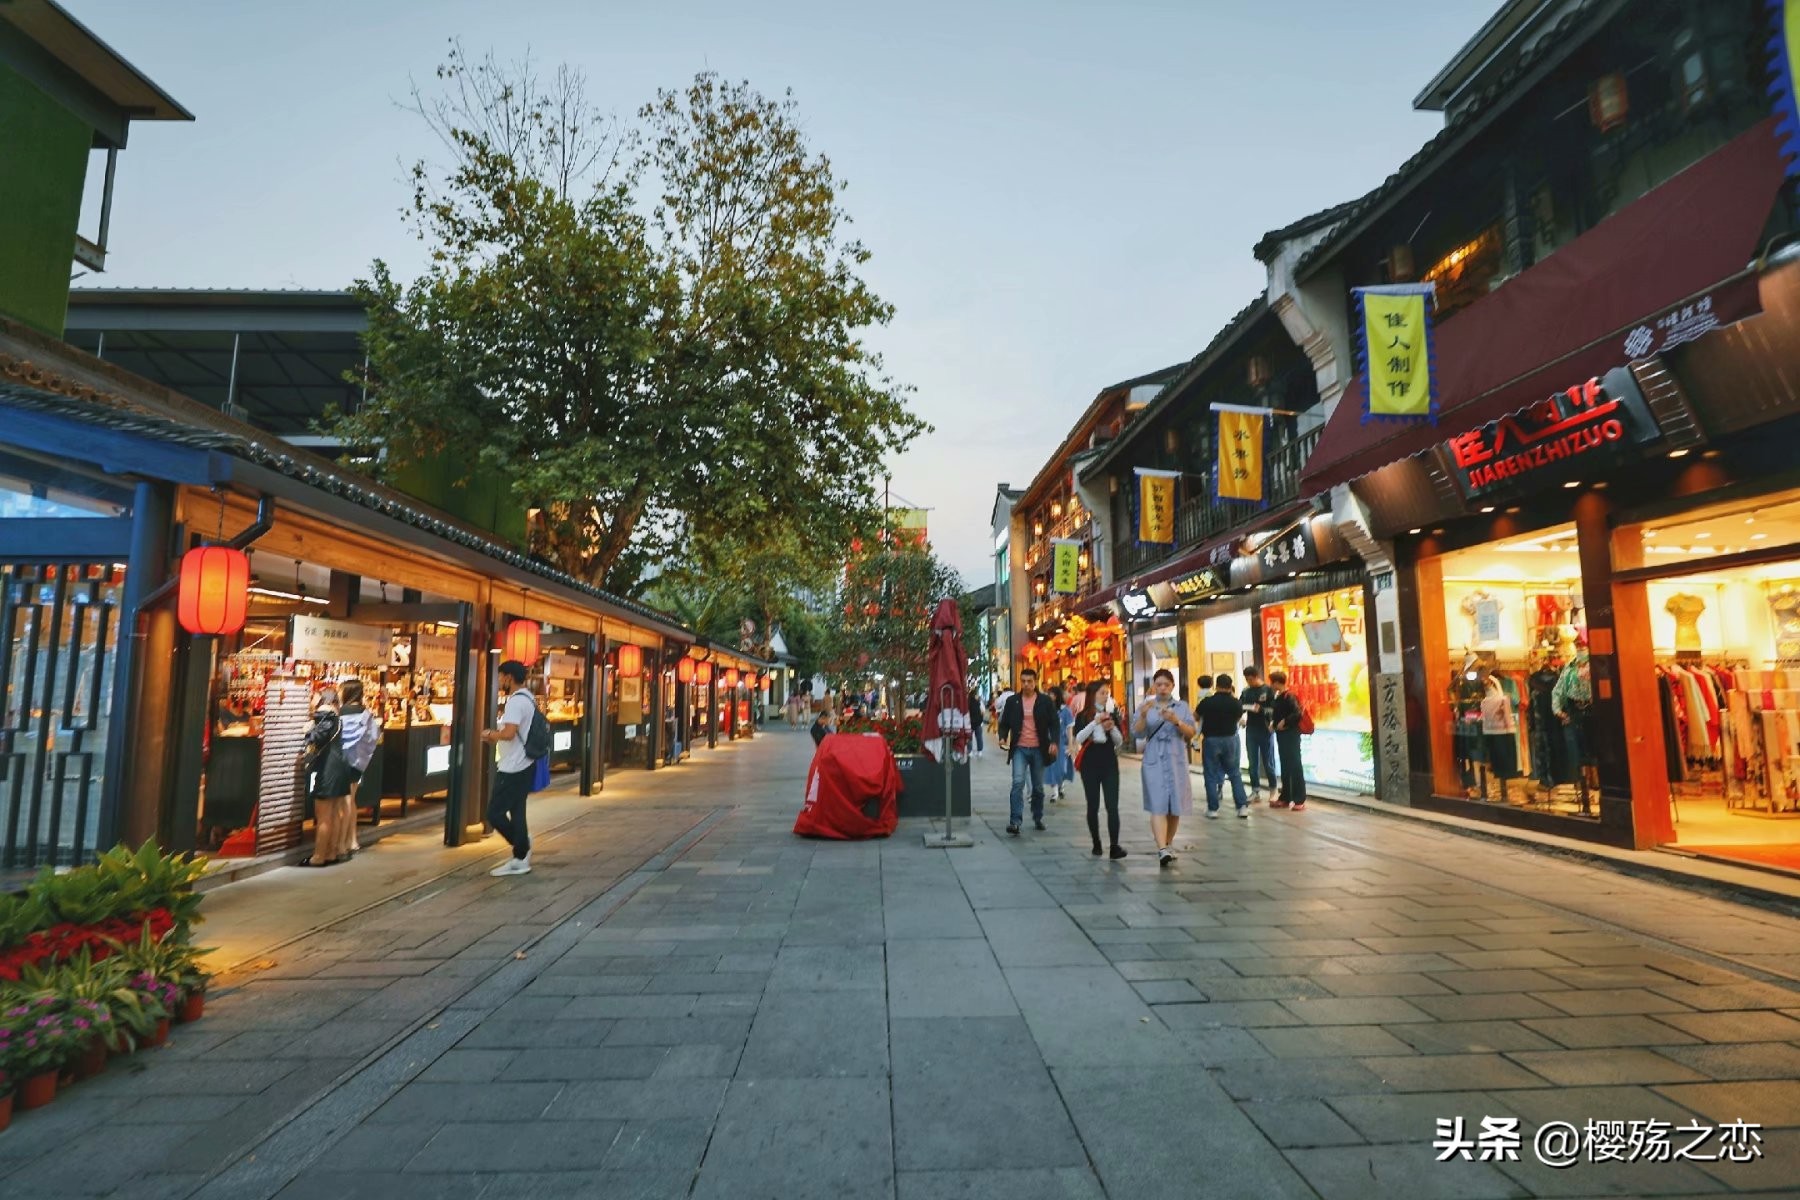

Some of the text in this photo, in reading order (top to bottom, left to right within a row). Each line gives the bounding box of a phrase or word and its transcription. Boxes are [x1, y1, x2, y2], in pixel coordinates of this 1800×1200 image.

[1384, 312, 1410, 397] 佳人制作
[1469, 419, 1623, 489] JIARENZHIZUO
[1264, 534, 1305, 568] 水果捞
